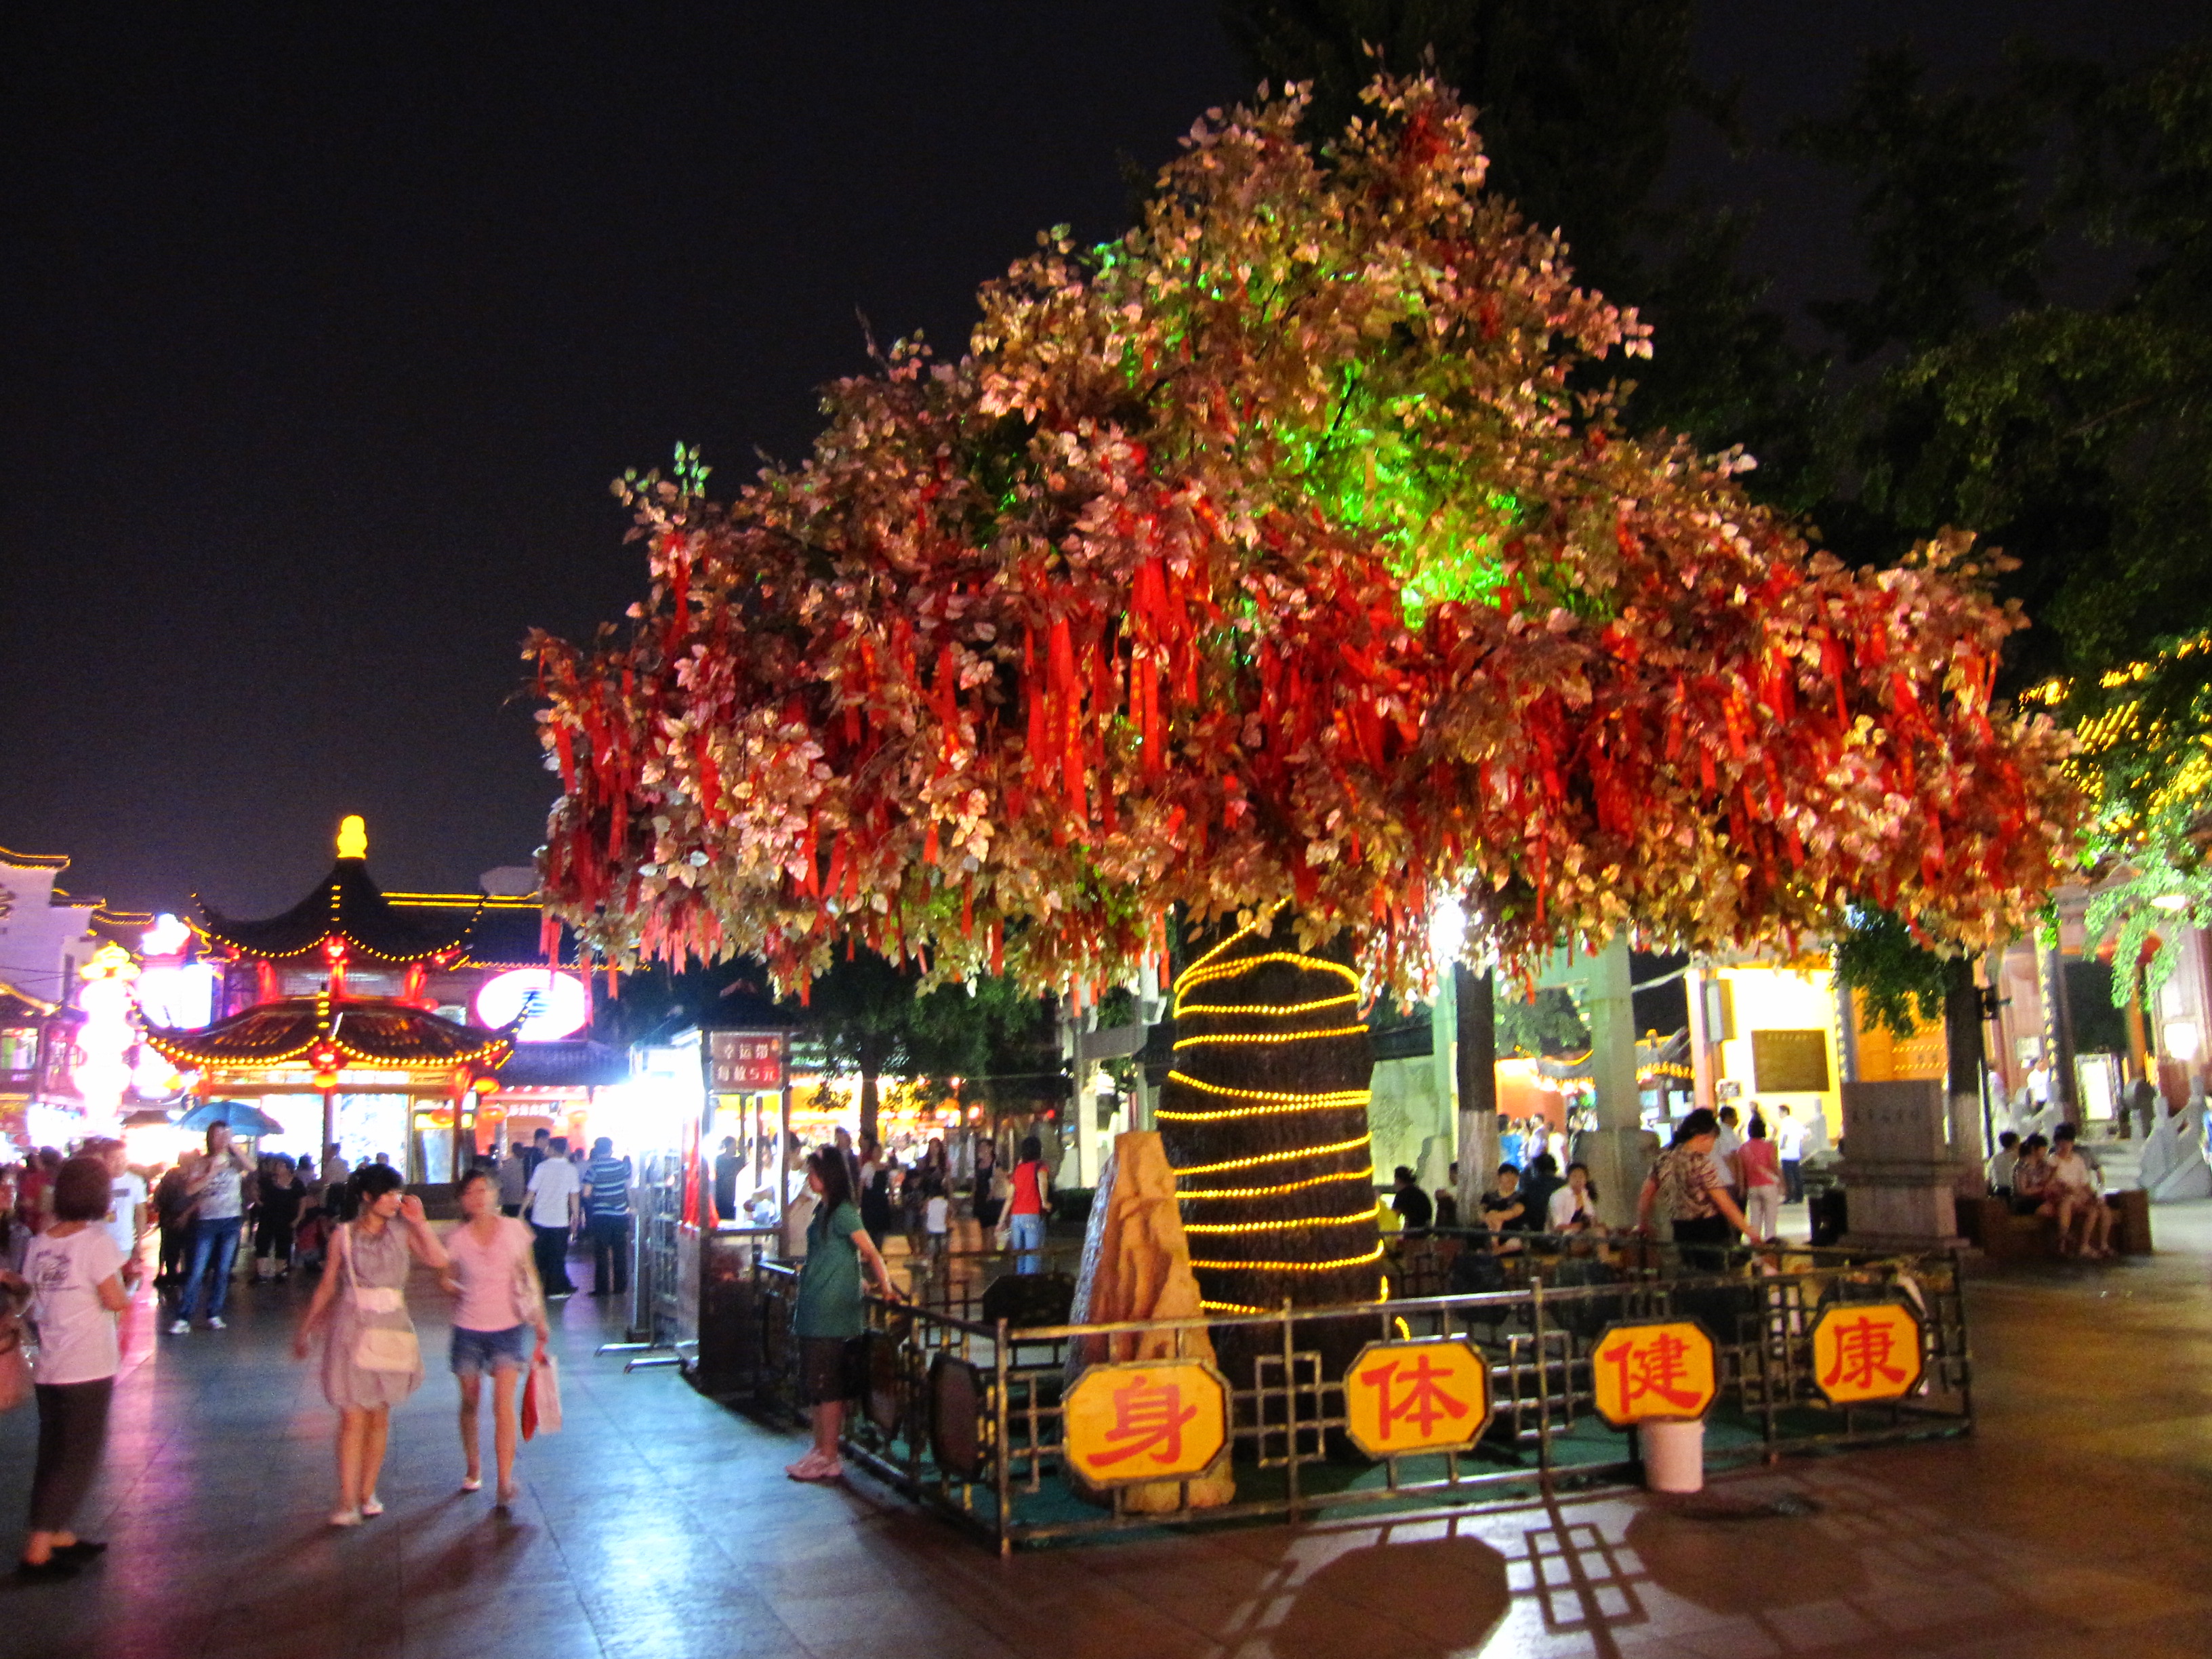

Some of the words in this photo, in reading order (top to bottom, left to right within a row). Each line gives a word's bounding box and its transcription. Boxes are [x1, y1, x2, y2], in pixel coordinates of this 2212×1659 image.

[1603, 1332, 1702, 1414] 健
[1823, 1316, 1906, 1389] 康
[1086, 1375, 1198, 1468] 身
[1361, 1354, 1469, 1441] 体
